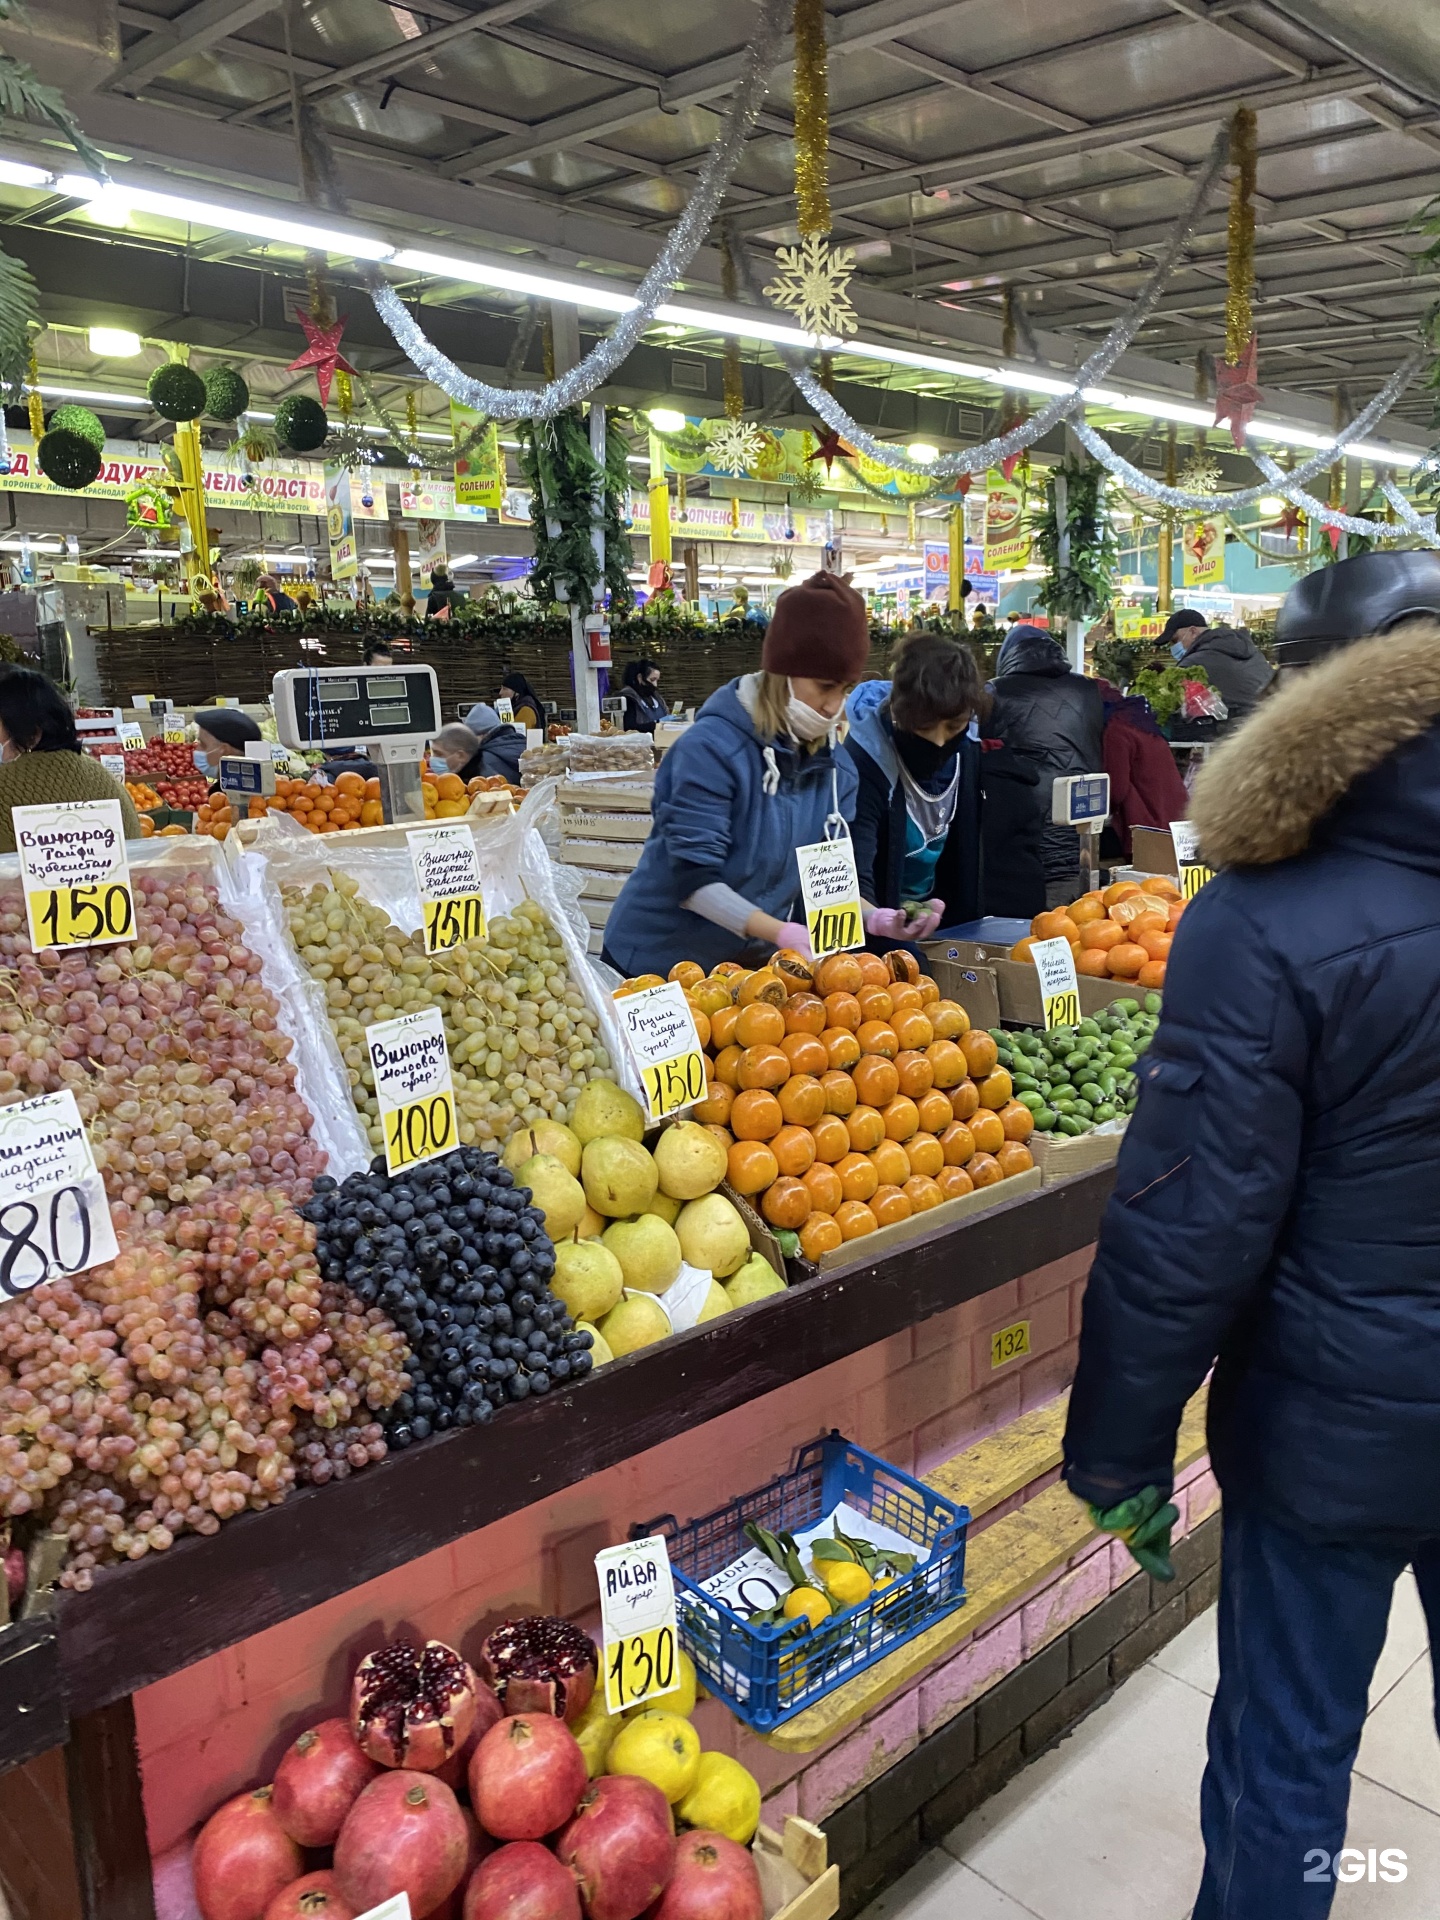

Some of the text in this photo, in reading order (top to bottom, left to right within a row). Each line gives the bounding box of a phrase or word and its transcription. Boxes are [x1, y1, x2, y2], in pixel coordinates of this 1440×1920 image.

[3, 480, 42, 490] ВОРОНЕЖ
[459, 480, 495, 492] СОЛЕНИЯ
[336, 543, 352, 562] МЁД
[987, 541, 1025, 557] СОЛЕНИЯ
[165, 731, 181, 742] 80
[20, 828, 115, 848] Виноград
[41, 845, 95, 860] Тайфи
[419, 850, 474, 868] Виноград
[29, 859, 112, 878] Узбекистан
[41, 885, 132, 945] 150
[428, 899, 482, 951] 150
[811, 909, 857, 953] 100
[627, 1008, 676, 1031] Груши
[1047, 995, 1077, 1030] 120
[371, 1034, 444, 1069] Виноград
[653, 1053, 704, 1116] 150
[390, 1097, 450, 1169] 100
[995, 1328, 1025, 1360] 132
[606, 1559, 657, 1597] АЙВА
[610, 1627, 674, 1706] 130
